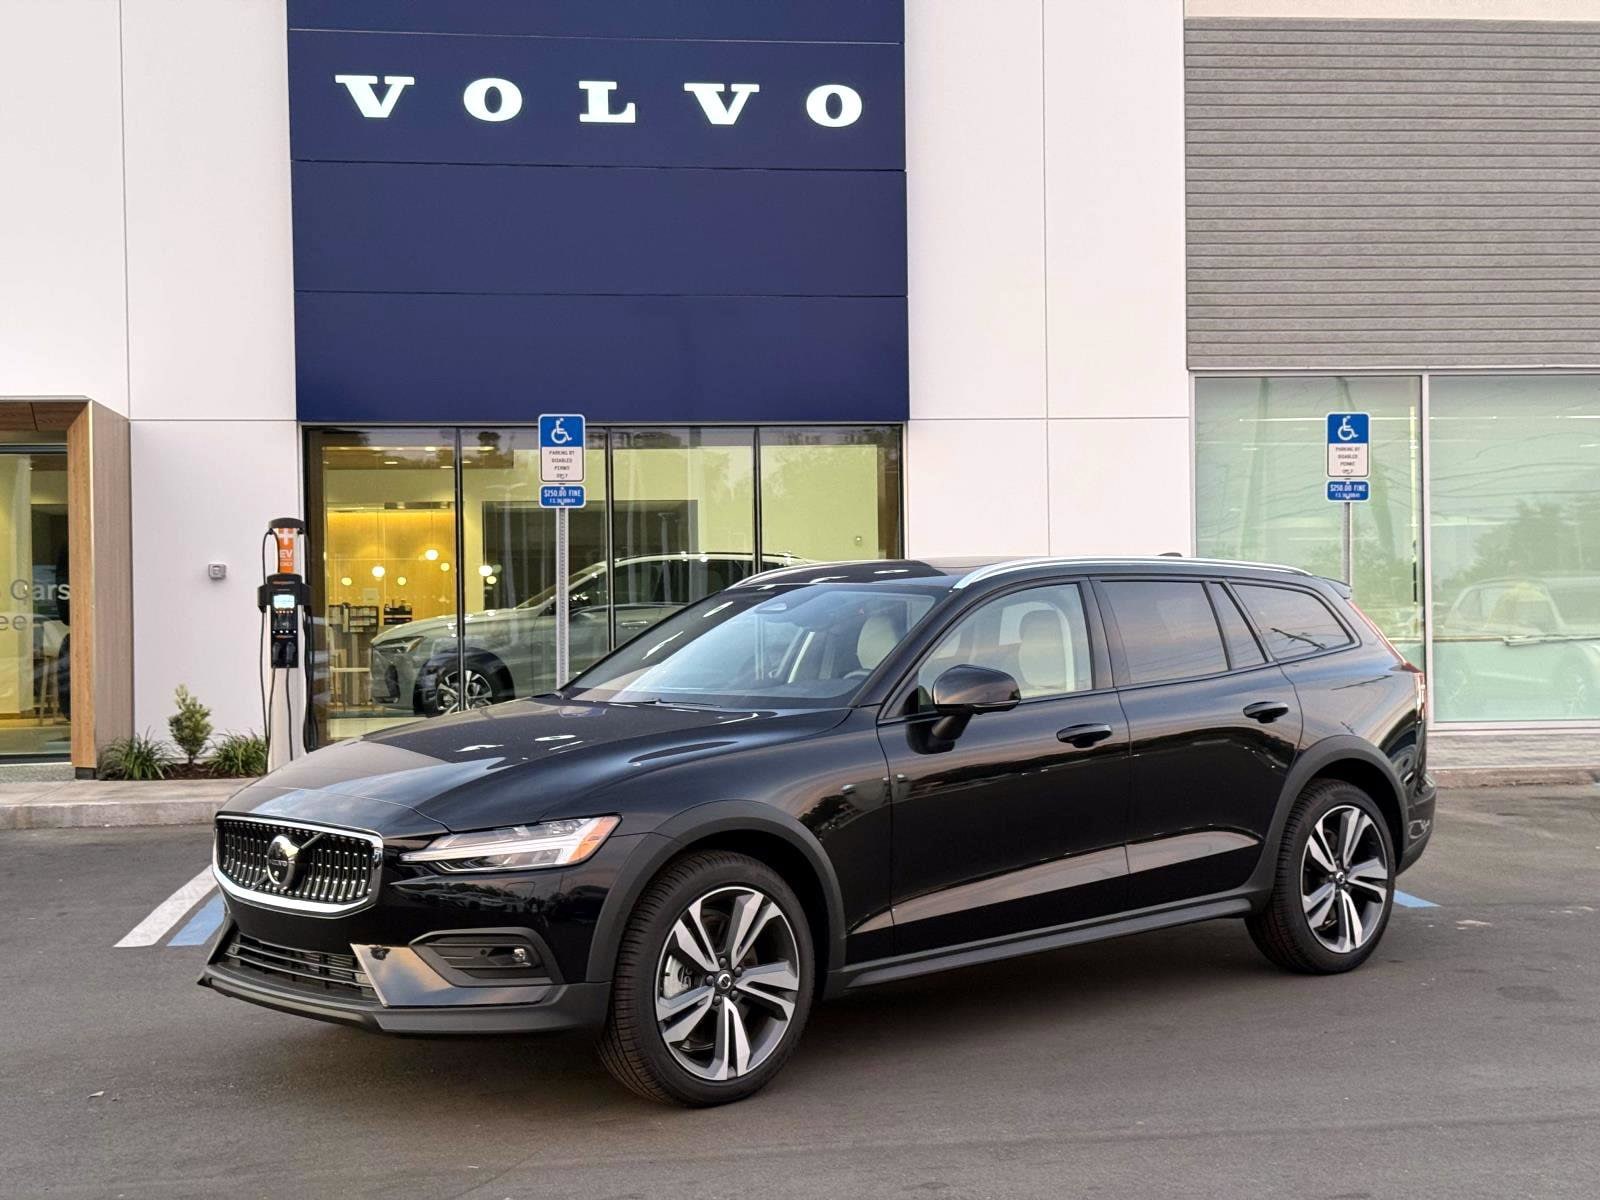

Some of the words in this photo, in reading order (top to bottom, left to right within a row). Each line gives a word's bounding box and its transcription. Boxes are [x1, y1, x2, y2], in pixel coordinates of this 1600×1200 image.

[335, 74, 862, 128] VOLVO
[543, 489, 567, 497] $250.00
[568, 489, 582, 497] FINE
[279, 549, 293, 558] EV
[11, 579, 71, 600] Cars
